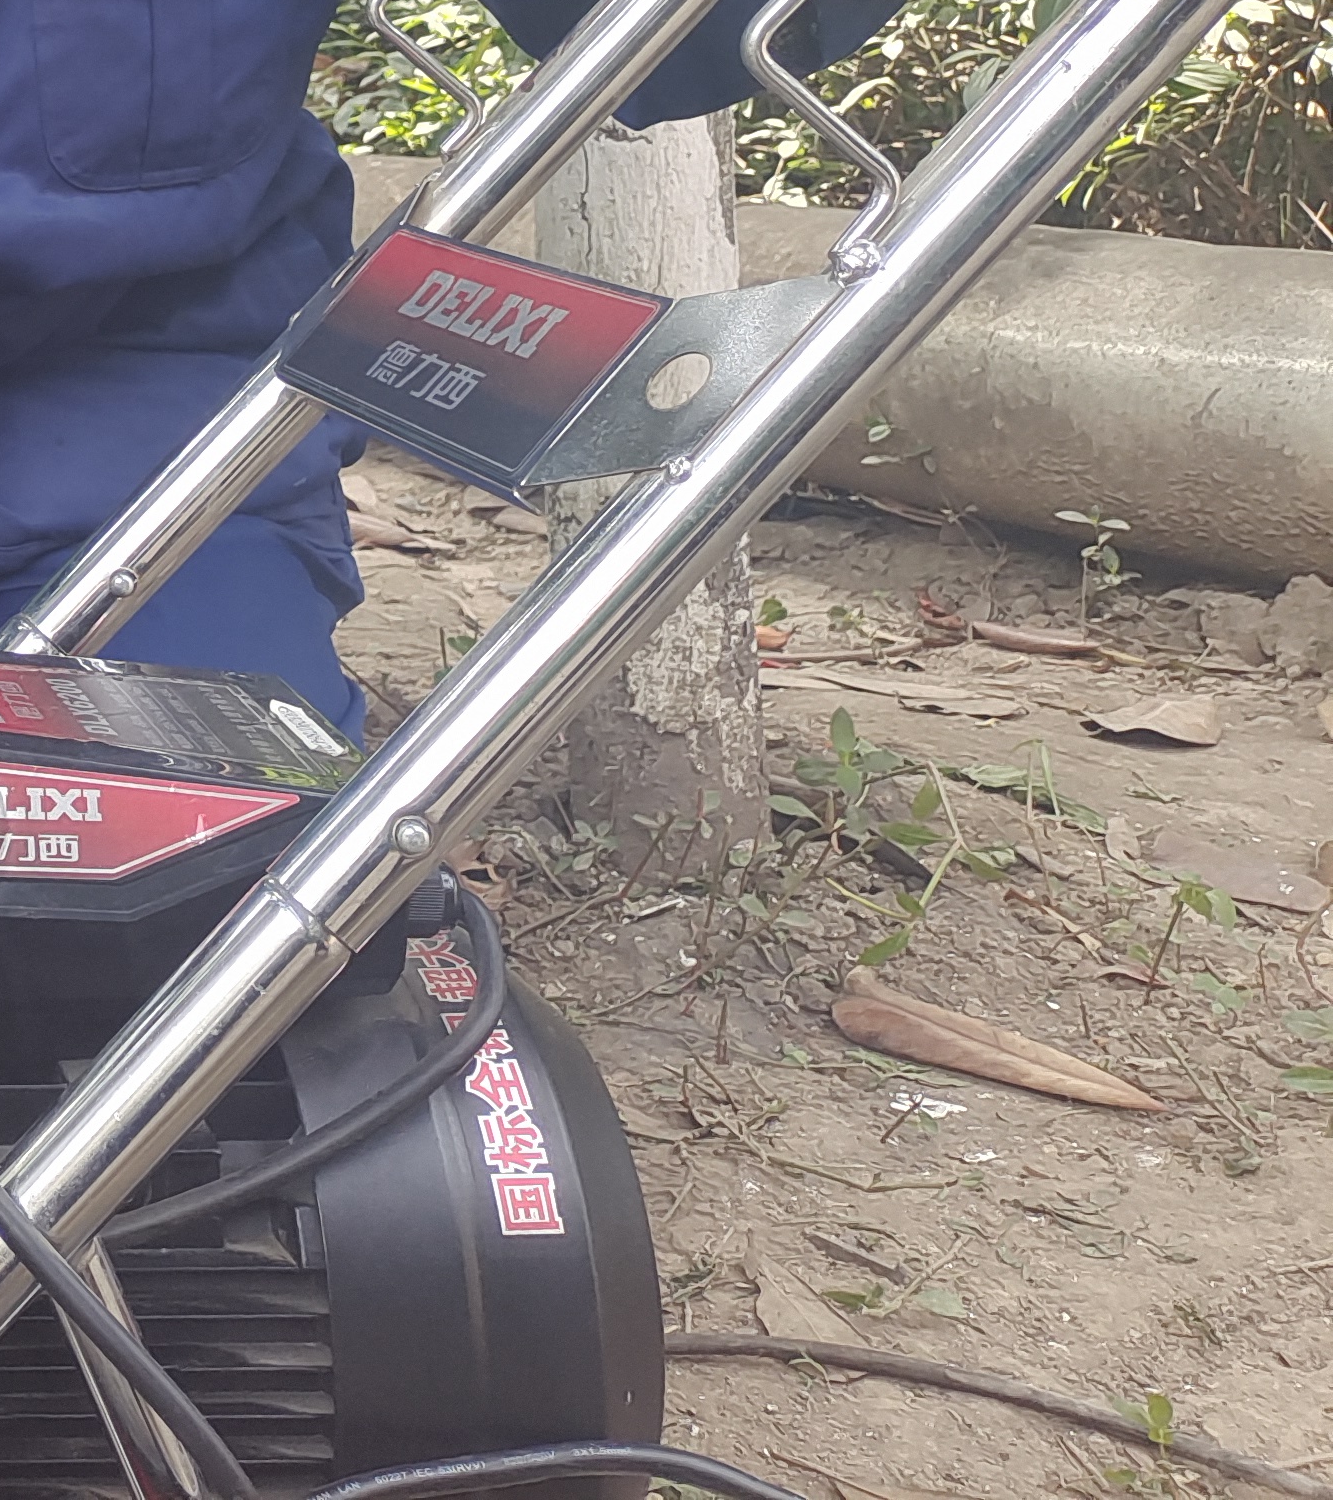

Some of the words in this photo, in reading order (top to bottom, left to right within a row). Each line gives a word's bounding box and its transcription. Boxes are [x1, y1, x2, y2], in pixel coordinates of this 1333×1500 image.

[399, 269, 570, 360] DELIXI
[366, 339, 488, 411] 德力西
[45, 678, 119, 737] DLX6200
